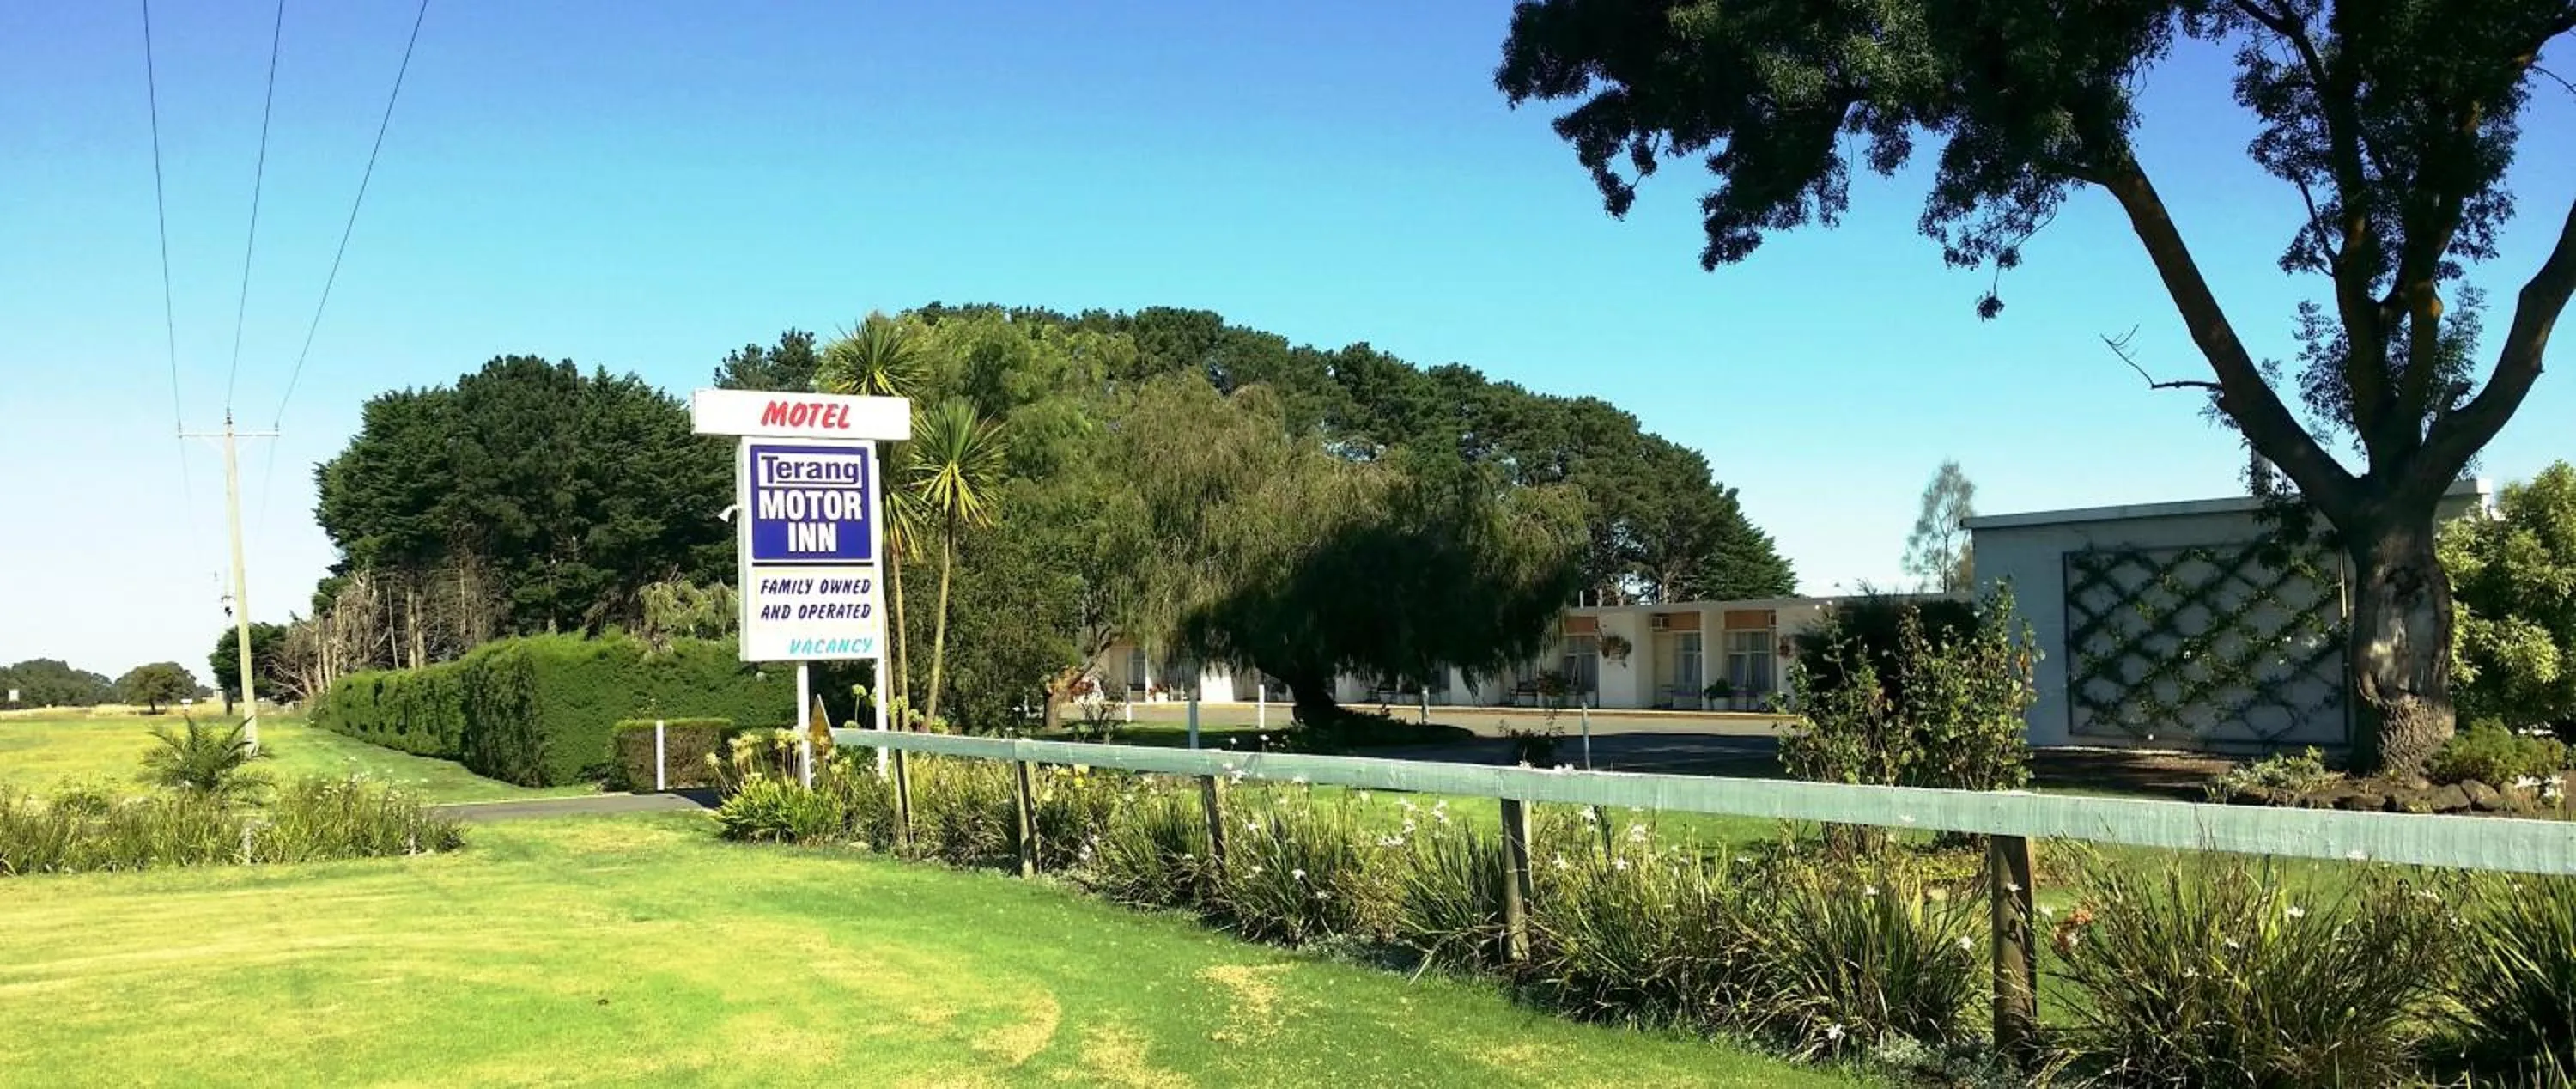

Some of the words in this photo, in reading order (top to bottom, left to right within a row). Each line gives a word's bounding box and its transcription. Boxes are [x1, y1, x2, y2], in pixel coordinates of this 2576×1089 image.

[761, 401, 851, 429] MOTEL
[761, 456, 859, 484] Terang
[758, 490, 863, 521] MOTOR
[787, 522, 837, 552] INN
[760, 579, 814, 595] FAMILY
[820, 579, 871, 594] OWNED
[761, 605, 791, 619] AND
[798, 604, 871, 619] OPERATED
[789, 637, 873, 654] VACANCY
